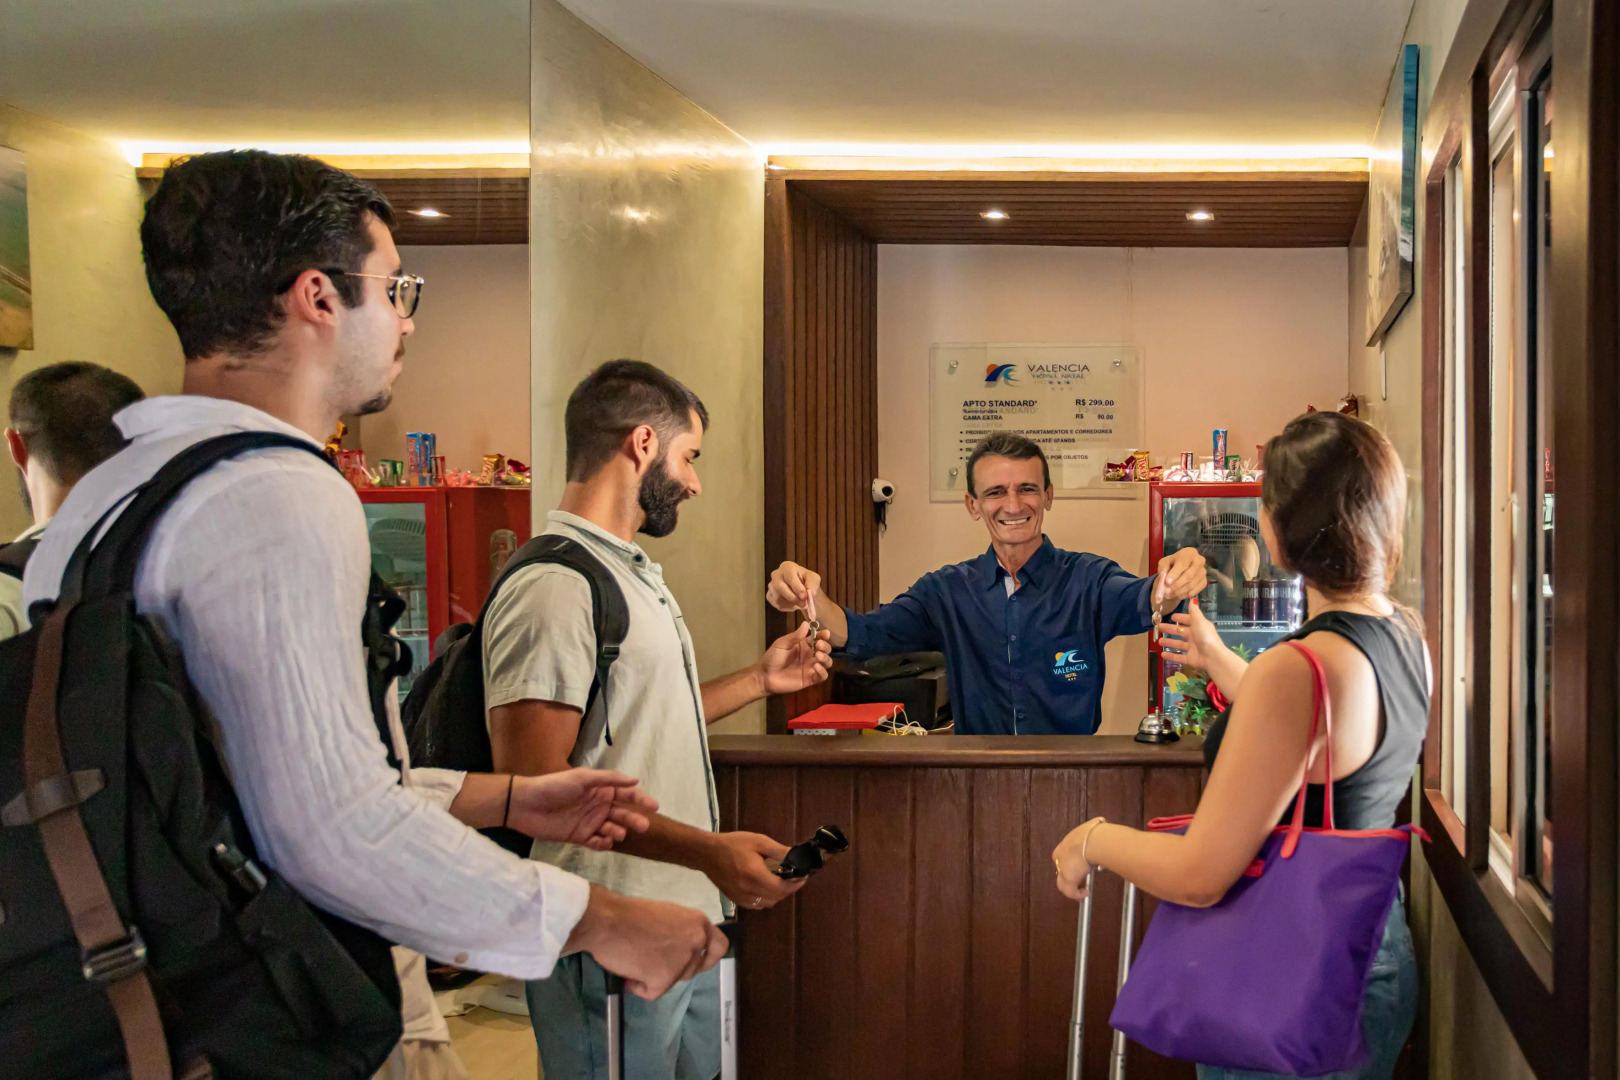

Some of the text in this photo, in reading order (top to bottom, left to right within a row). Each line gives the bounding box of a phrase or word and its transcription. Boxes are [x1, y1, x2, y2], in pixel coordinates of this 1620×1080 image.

[1027, 363, 1090, 373] VALENCIA
[1075, 399, 1086, 407] R$
[1053, 663, 1088, 675] VALENCIA
